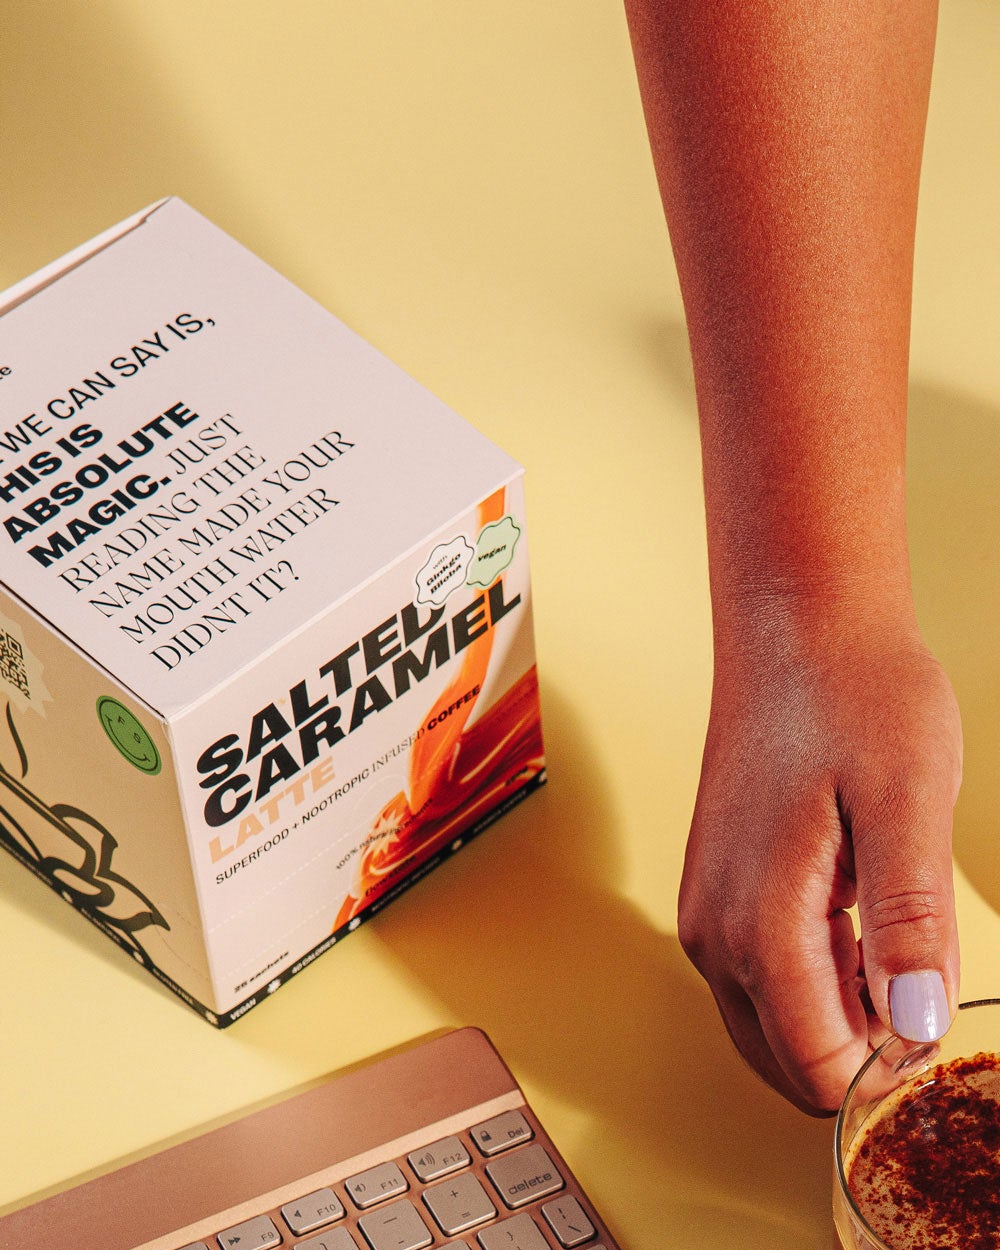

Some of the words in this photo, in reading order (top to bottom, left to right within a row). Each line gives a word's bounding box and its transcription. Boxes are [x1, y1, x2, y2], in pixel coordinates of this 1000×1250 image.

[0, 413, 53, 454] WE
[47, 371, 116, 420] CAN
[110, 330, 170, 378] SAY
[167, 311, 217, 341] IS,
[0, 451, 63, 504] HIS
[56, 423, 104, 458] IS
[2, 401, 200, 544] ABSOLUTE
[27, 474, 172, 569] MAGIC.
[165, 412, 243, 475] JUST
[56, 491, 203, 594] READING
[192, 445, 267, 497] THE
[88, 548, 186, 620] NAME
[177, 482, 274, 556] MADE
[262, 430, 355, 494] YOUR
[118, 556, 240, 645] MOUTH
[229, 487, 340, 564] WATER
[426, 553, 461, 586] Ginkgo
[478, 544, 507, 562] vegan
[148, 592, 252, 671] DIDNT
[247, 559, 300, 603] IT?
[195, 602, 447, 790] SALTED
[203, 579, 522, 830] CARAMEL
[206, 756, 337, 865] LATTE
[215, 827, 291, 886] SUPERFOOD
[301, 768, 371, 826] NOOTROPIC
[372, 727, 426, 773] INFUSED
[426, 684, 481, 731] COFFEE
[380, 1177, 399, 1190] F11
[442, 1152, 463, 1166] F12
[507, 1127, 525, 1138] Del
[508, 1171, 553, 1195] delete
[260, 1231, 275, 1242] F9
[316, 1203, 337, 1217] F10
